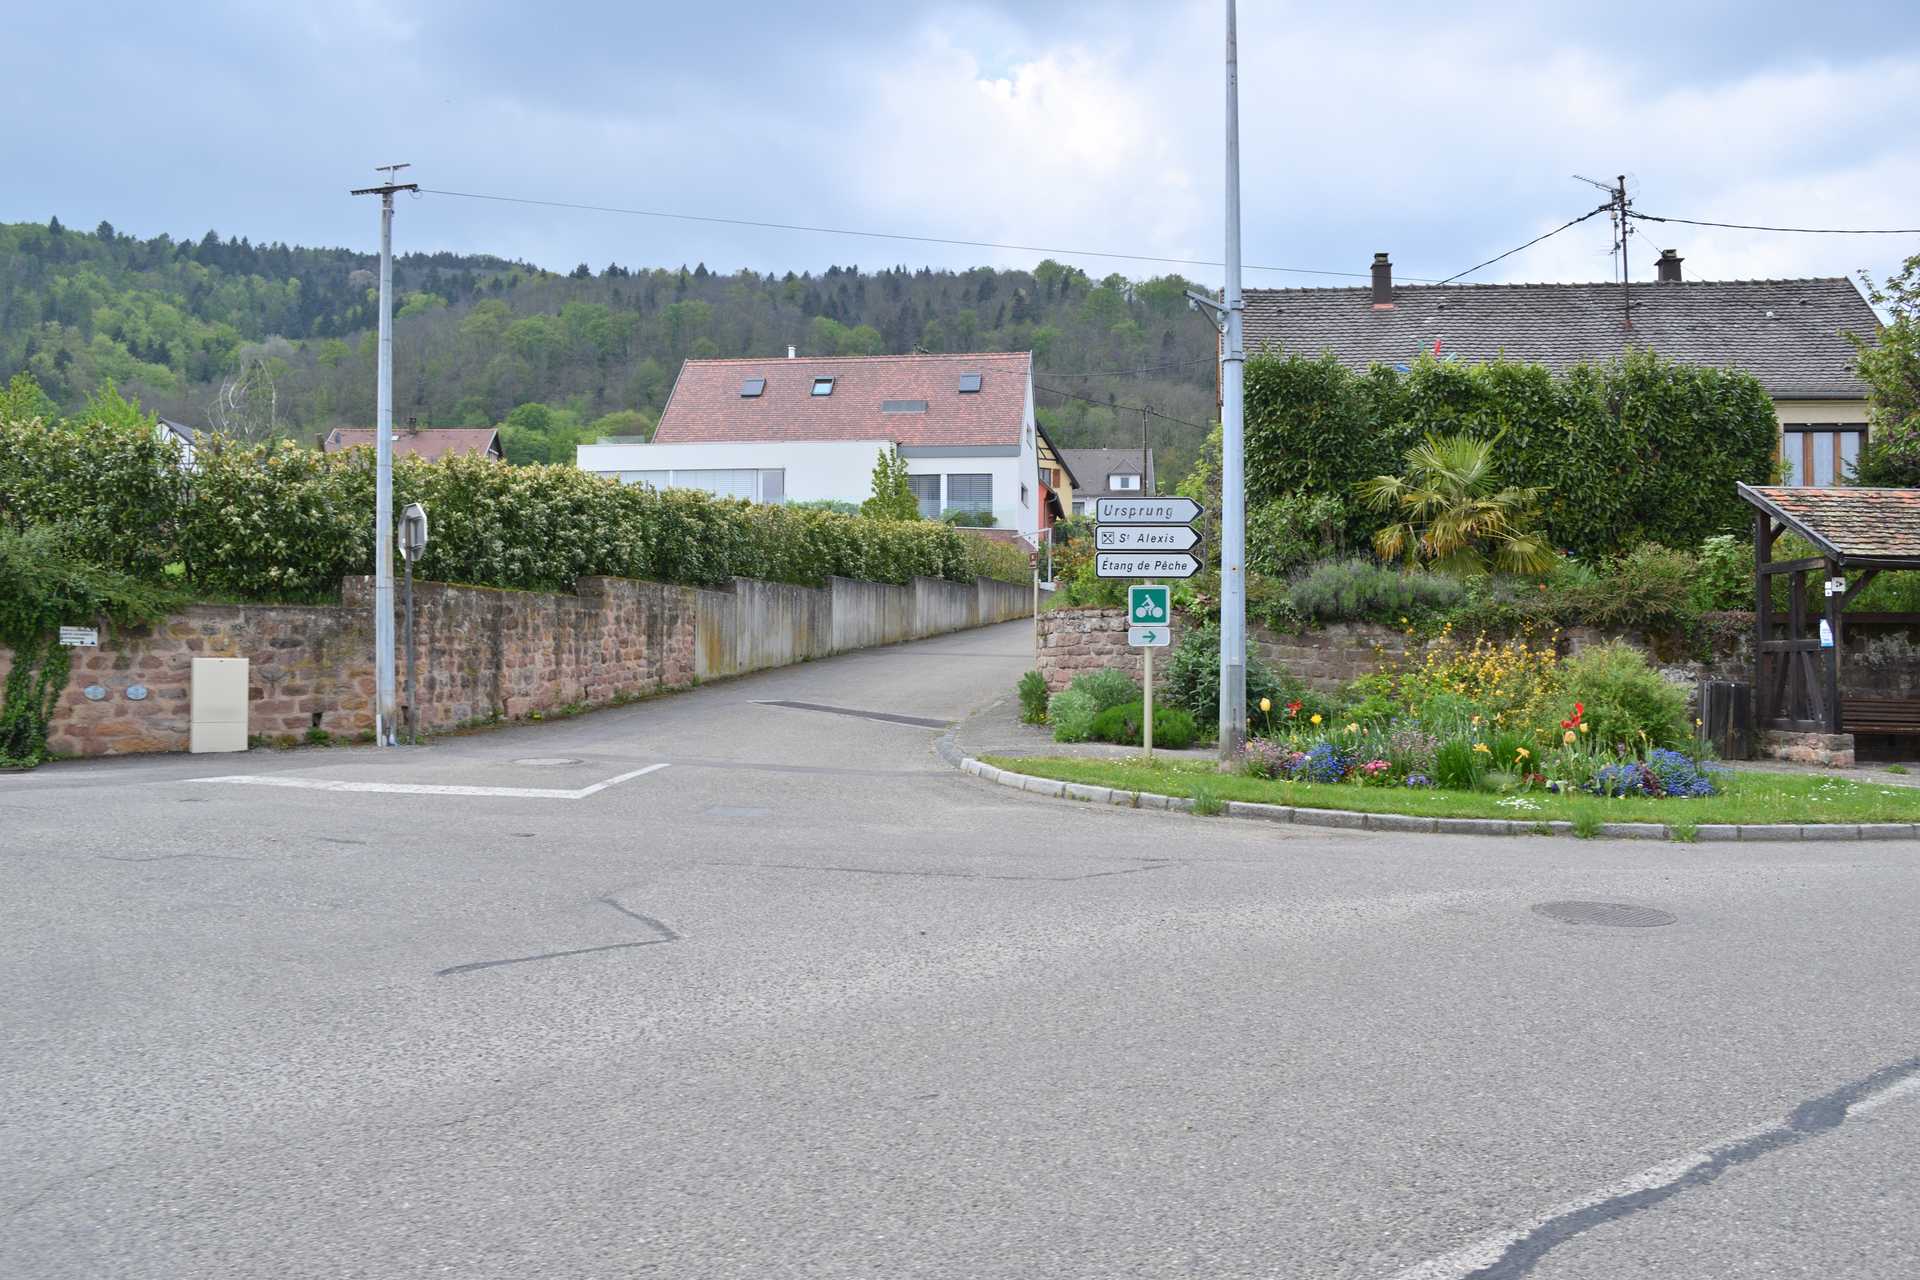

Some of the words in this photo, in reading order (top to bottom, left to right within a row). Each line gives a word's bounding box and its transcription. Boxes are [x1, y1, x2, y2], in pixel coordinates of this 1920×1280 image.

[1103, 504, 1174, 519] Ursprung
[1136, 533, 1175, 543] Alexis
[1137, 560, 1150, 570] de
[1154, 560, 1188, 570] Pêche
